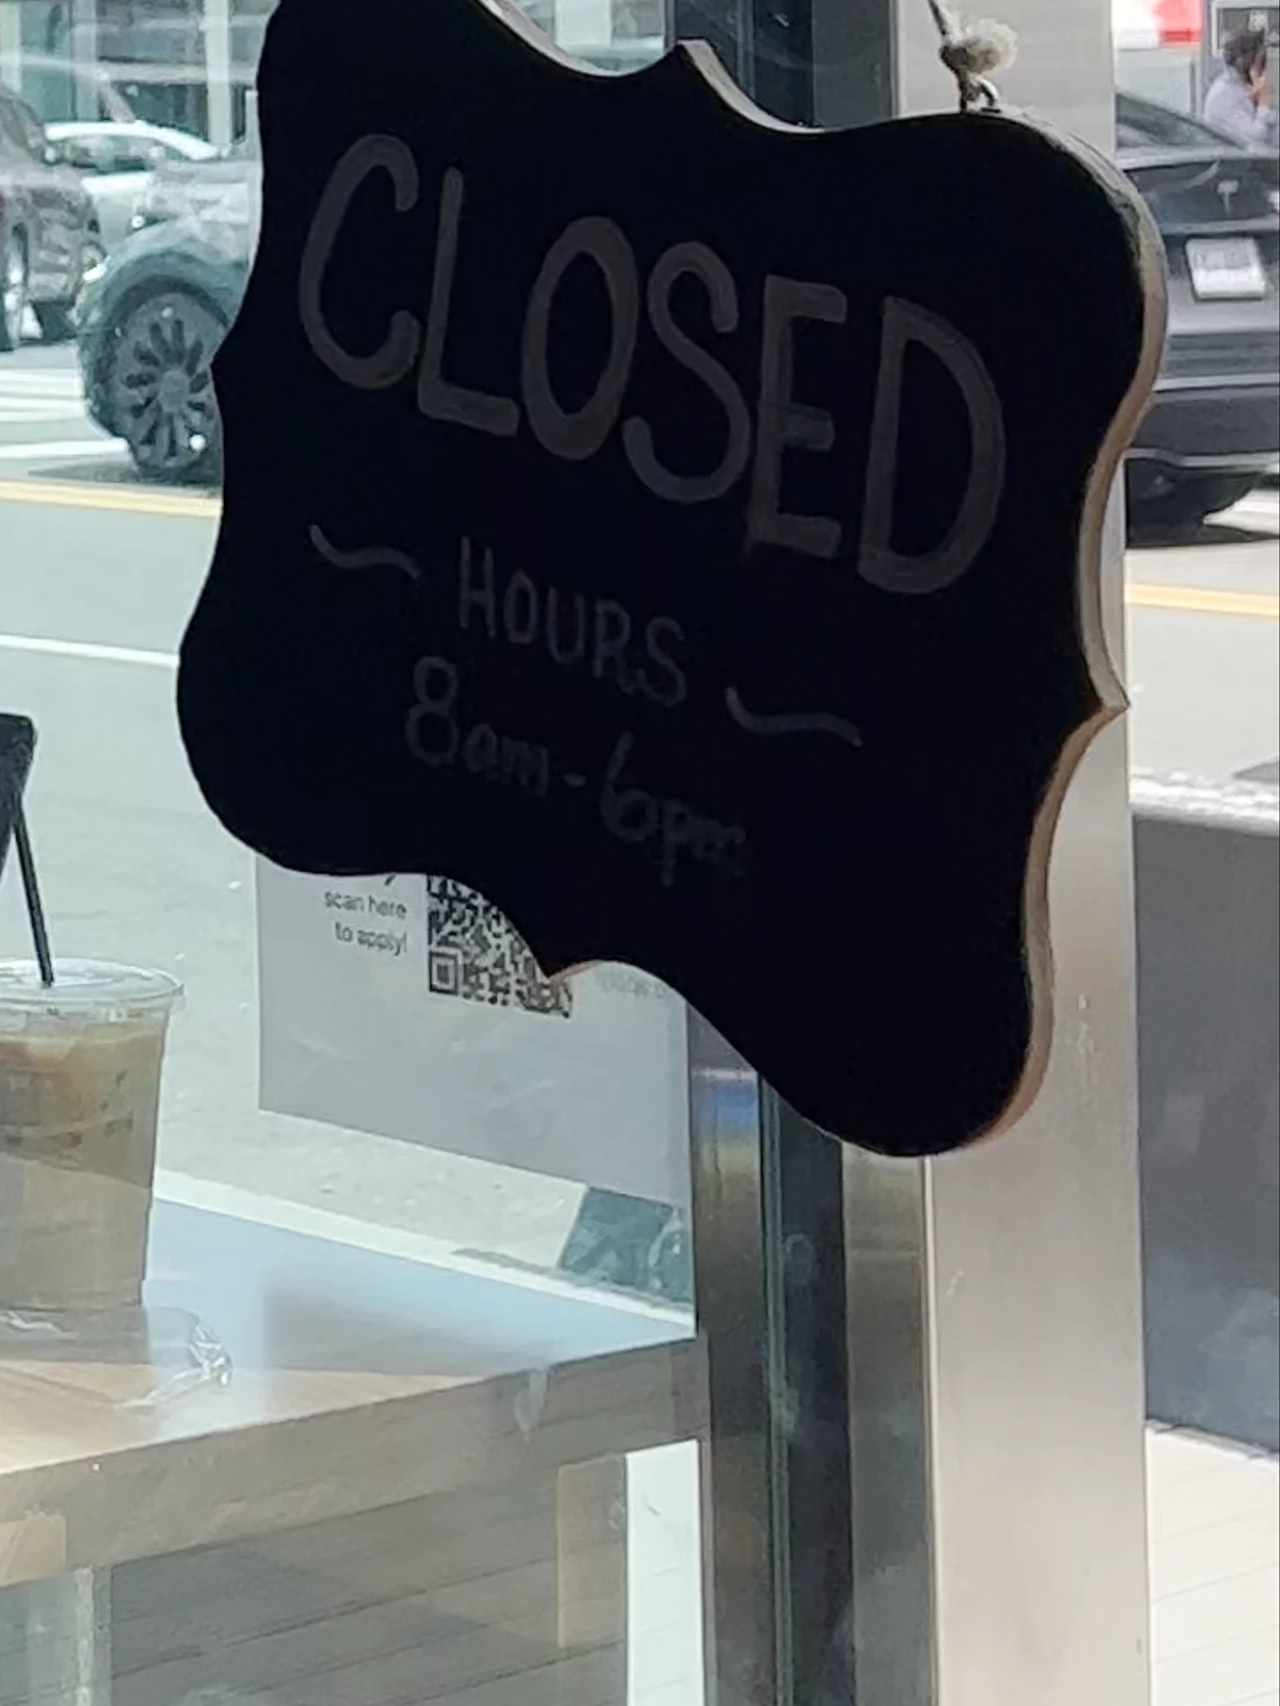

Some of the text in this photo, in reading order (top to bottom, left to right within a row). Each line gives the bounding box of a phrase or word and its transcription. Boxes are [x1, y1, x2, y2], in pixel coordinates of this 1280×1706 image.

[298, 132, 1005, 594] CLOSED
[456, 534, 689, 708] HOURS
[324, 891, 408, 920] scan here
[335, 921, 354, 943] to
